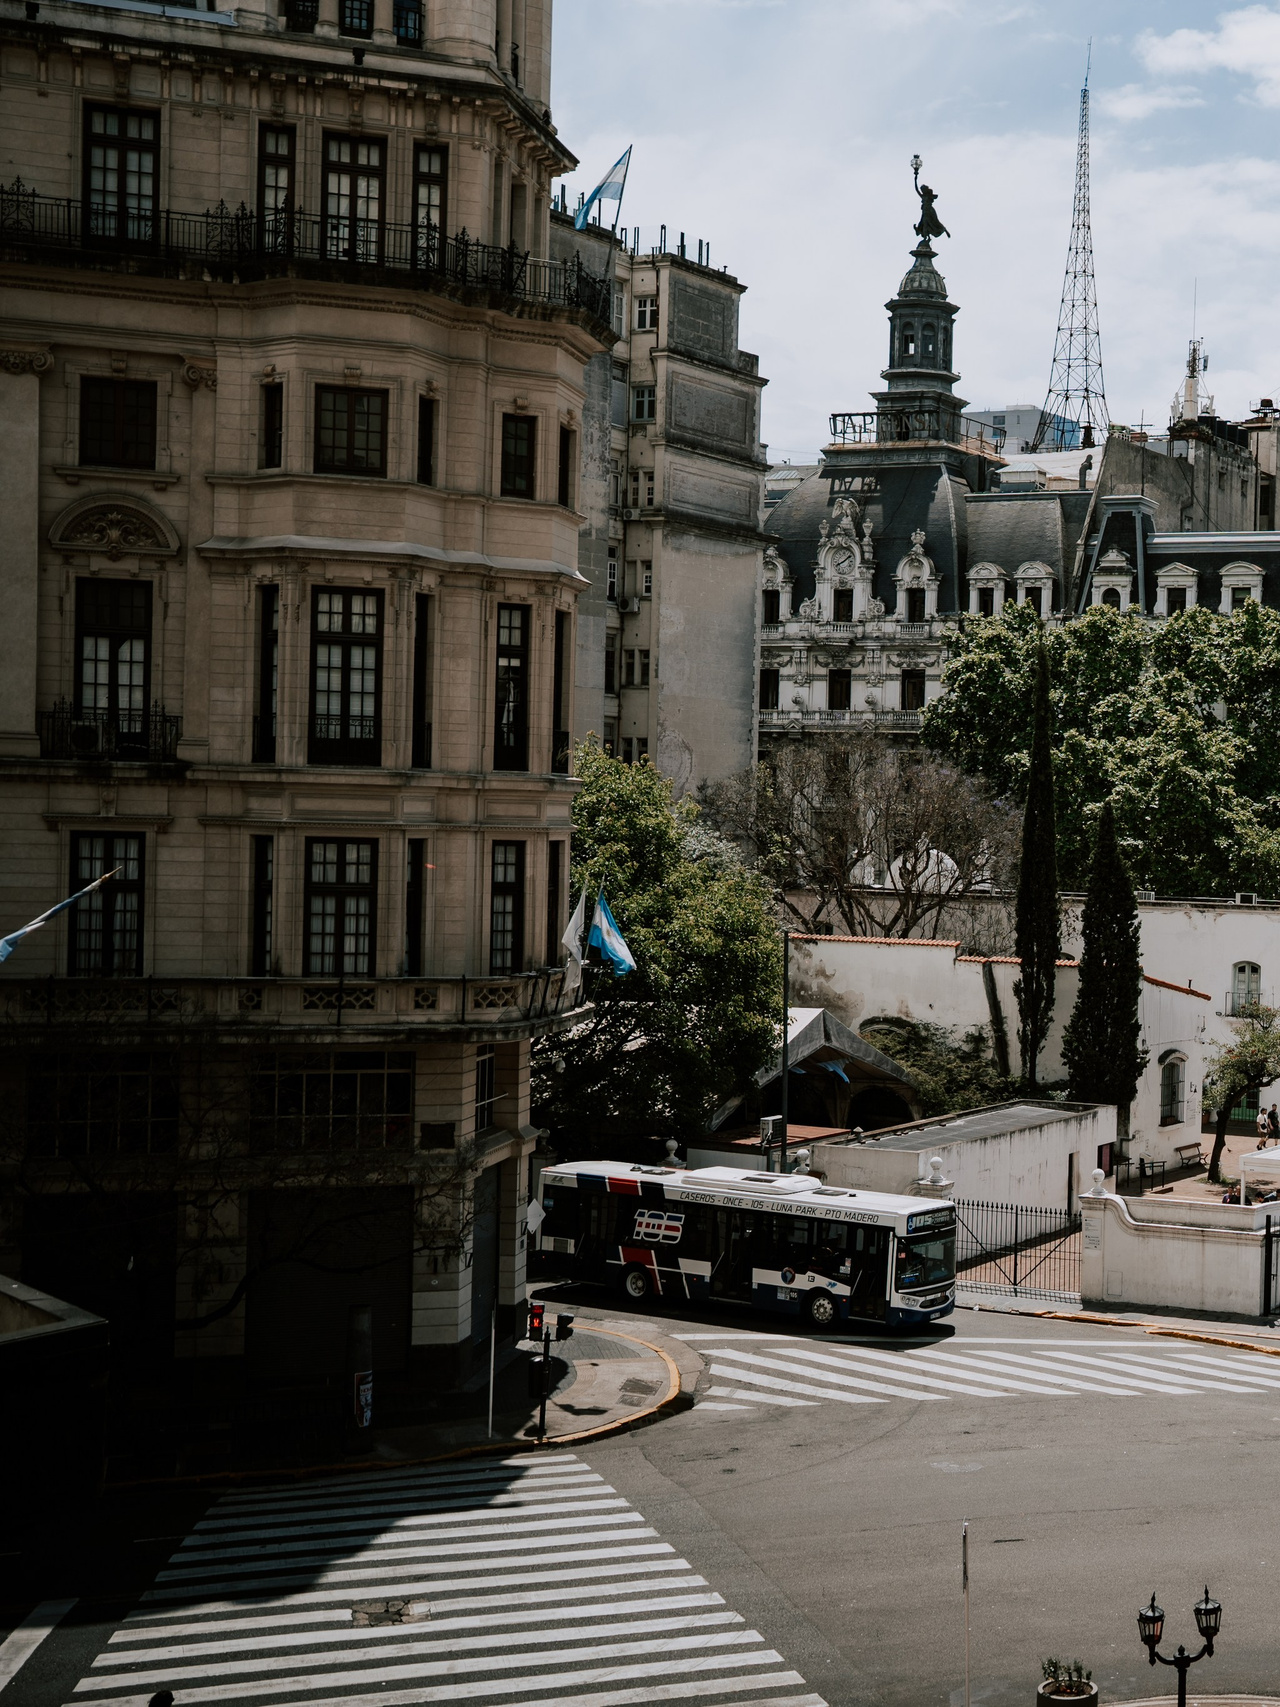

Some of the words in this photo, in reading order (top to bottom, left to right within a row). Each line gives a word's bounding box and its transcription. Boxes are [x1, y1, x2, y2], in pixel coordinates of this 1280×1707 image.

[832, 414, 857, 433] LA
[863, 412, 940, 433] PRENSA
[679, 1191, 716, 1204] CASEROS
[722, 1196, 745, 1207] ONCE
[750, 1200, 764, 1209] 105
[771, 1202, 793, 1213] LUNA
[795, 1205, 818, 1216] PARK
[824, 1209, 842, 1219] PTO
[844, 1211, 880, 1224] MADERO
[912, 1214, 933, 1228] 105
[633, 1209, 685, 1244] 105
